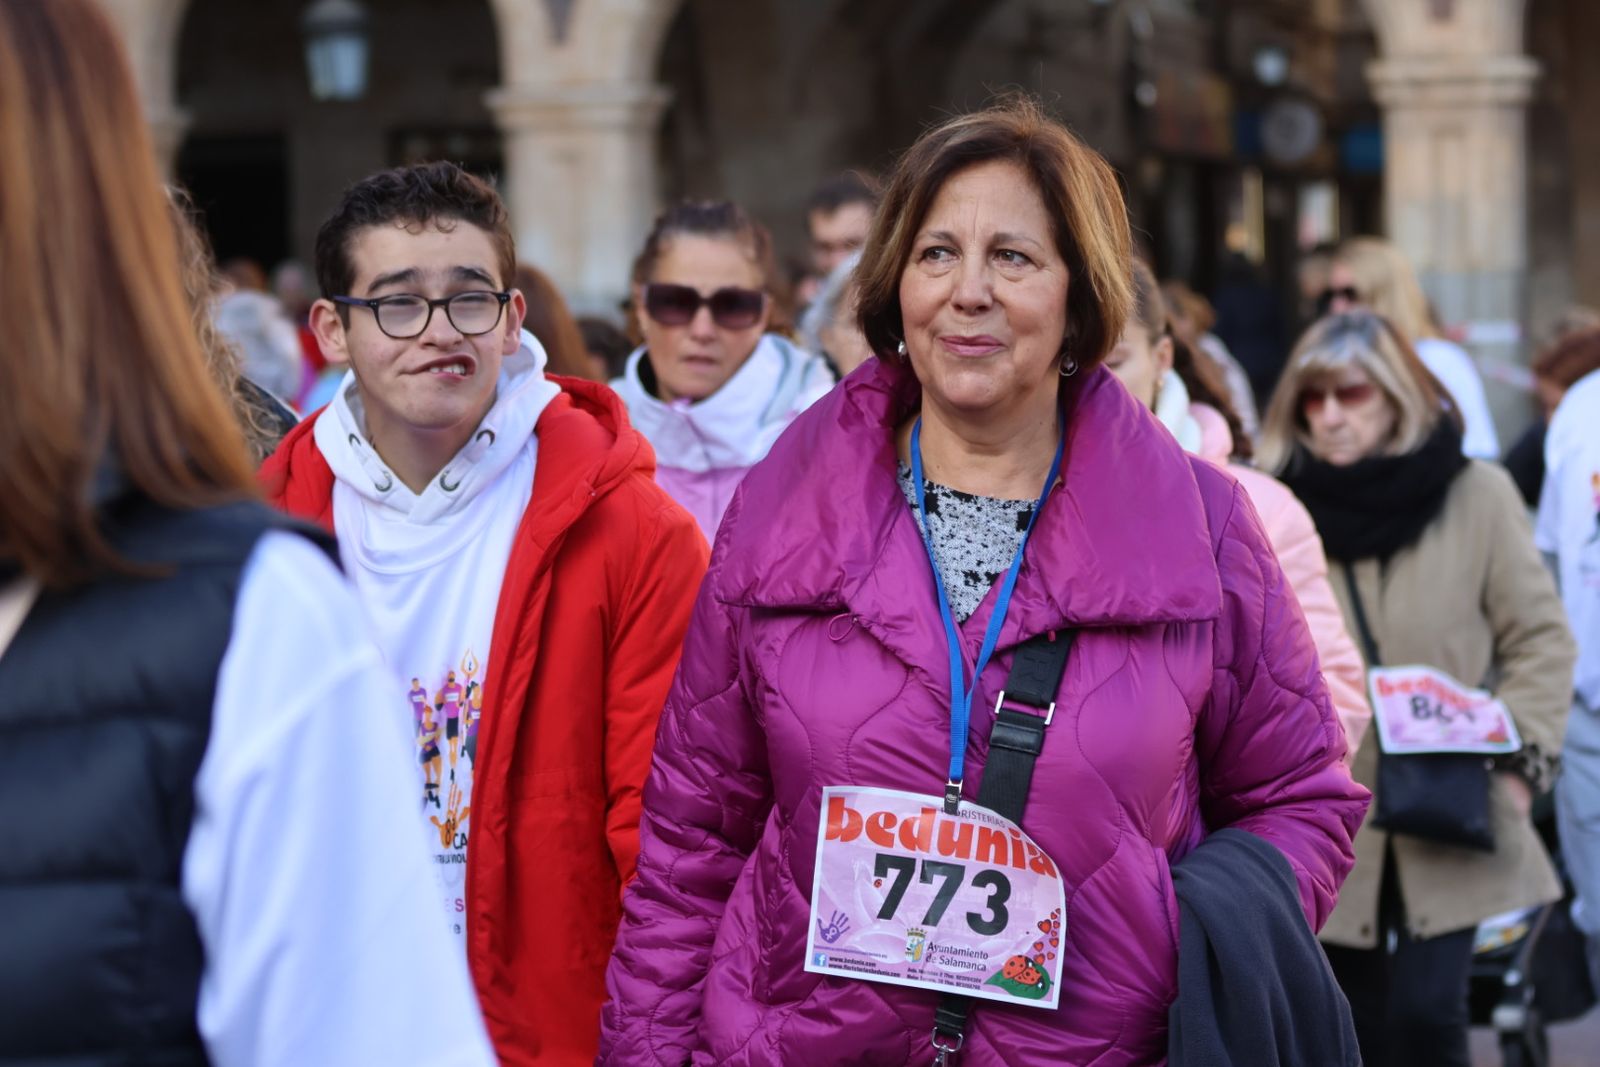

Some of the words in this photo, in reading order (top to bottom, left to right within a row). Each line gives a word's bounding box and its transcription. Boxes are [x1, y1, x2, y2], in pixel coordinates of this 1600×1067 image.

[825, 797, 1057, 878] bedunia
[873, 853, 1011, 936] 773
[926, 953, 938, 964] de
[939, 955, 987, 972] Salamanca
[927, 942, 989, 960] Ayuntamiento
